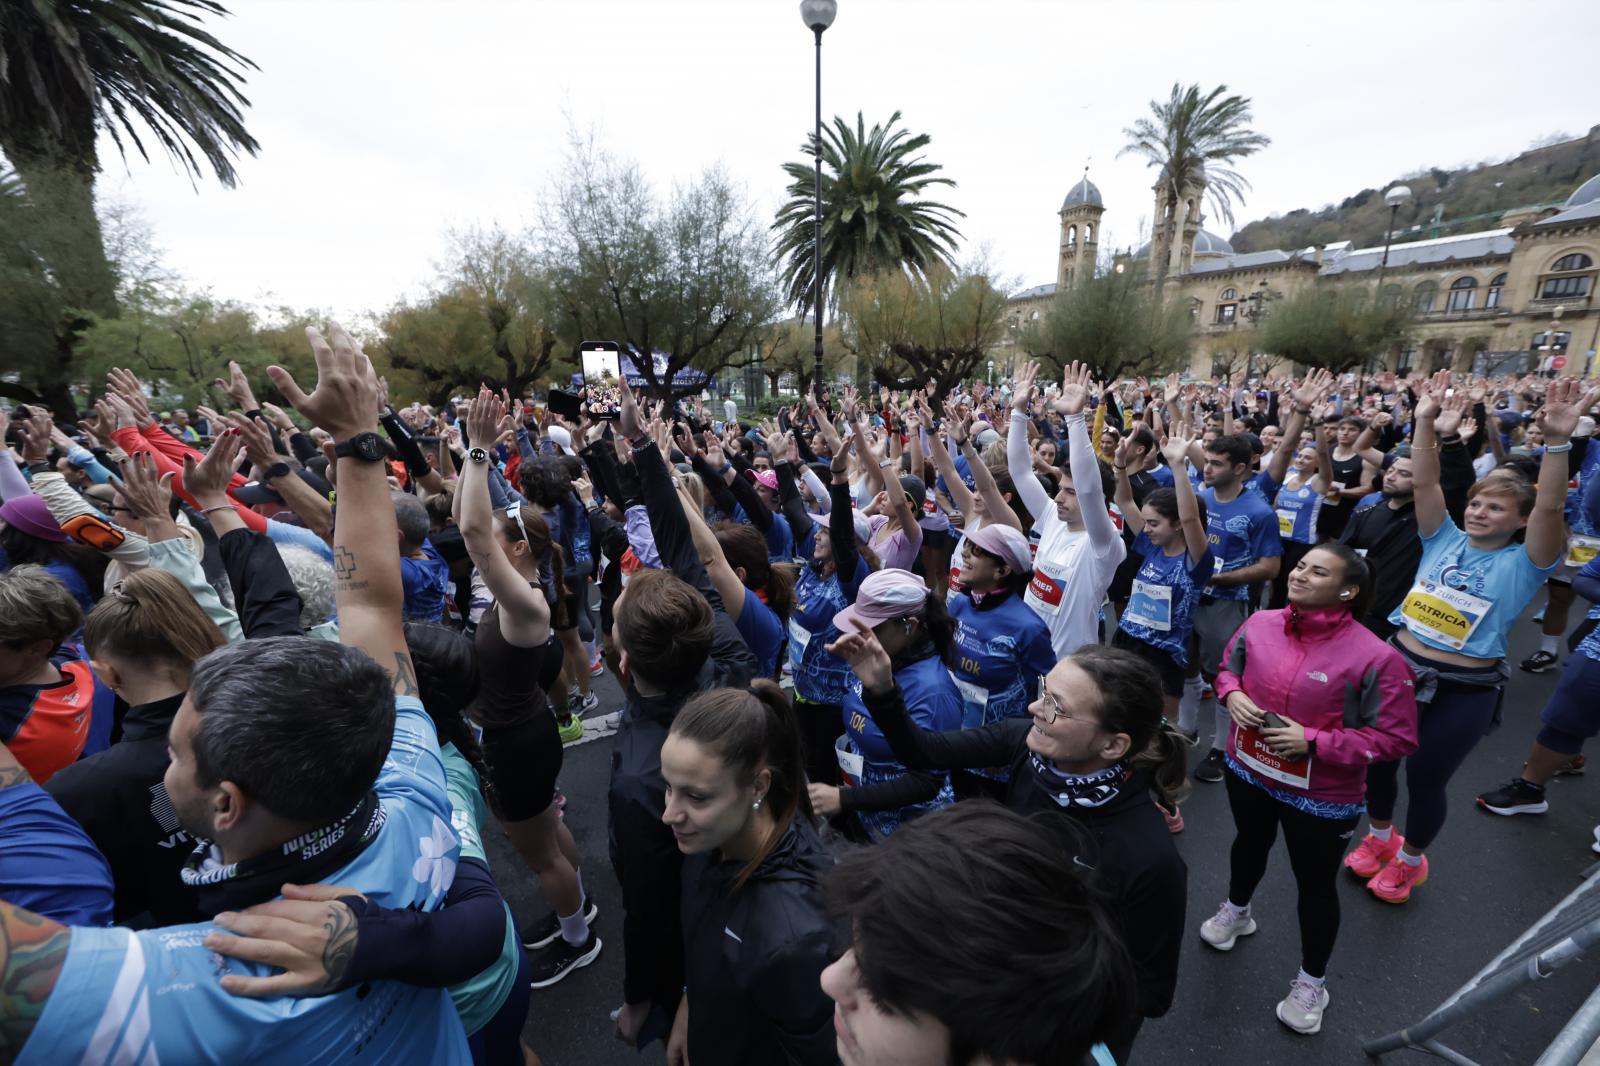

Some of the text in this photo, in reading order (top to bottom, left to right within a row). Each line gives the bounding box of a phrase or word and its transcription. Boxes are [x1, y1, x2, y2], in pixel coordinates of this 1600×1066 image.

[1040, 564, 1061, 575] RICH
[1438, 589, 1473, 608] ZURICH
[1413, 600, 1467, 629] PATRICIA
[1418, 613, 1443, 628] 12757
[960, 656, 981, 675] 10k
[849, 711, 867, 734] 10k
[1256, 752, 1281, 769] 10919
[302, 826, 345, 860] SERIES
